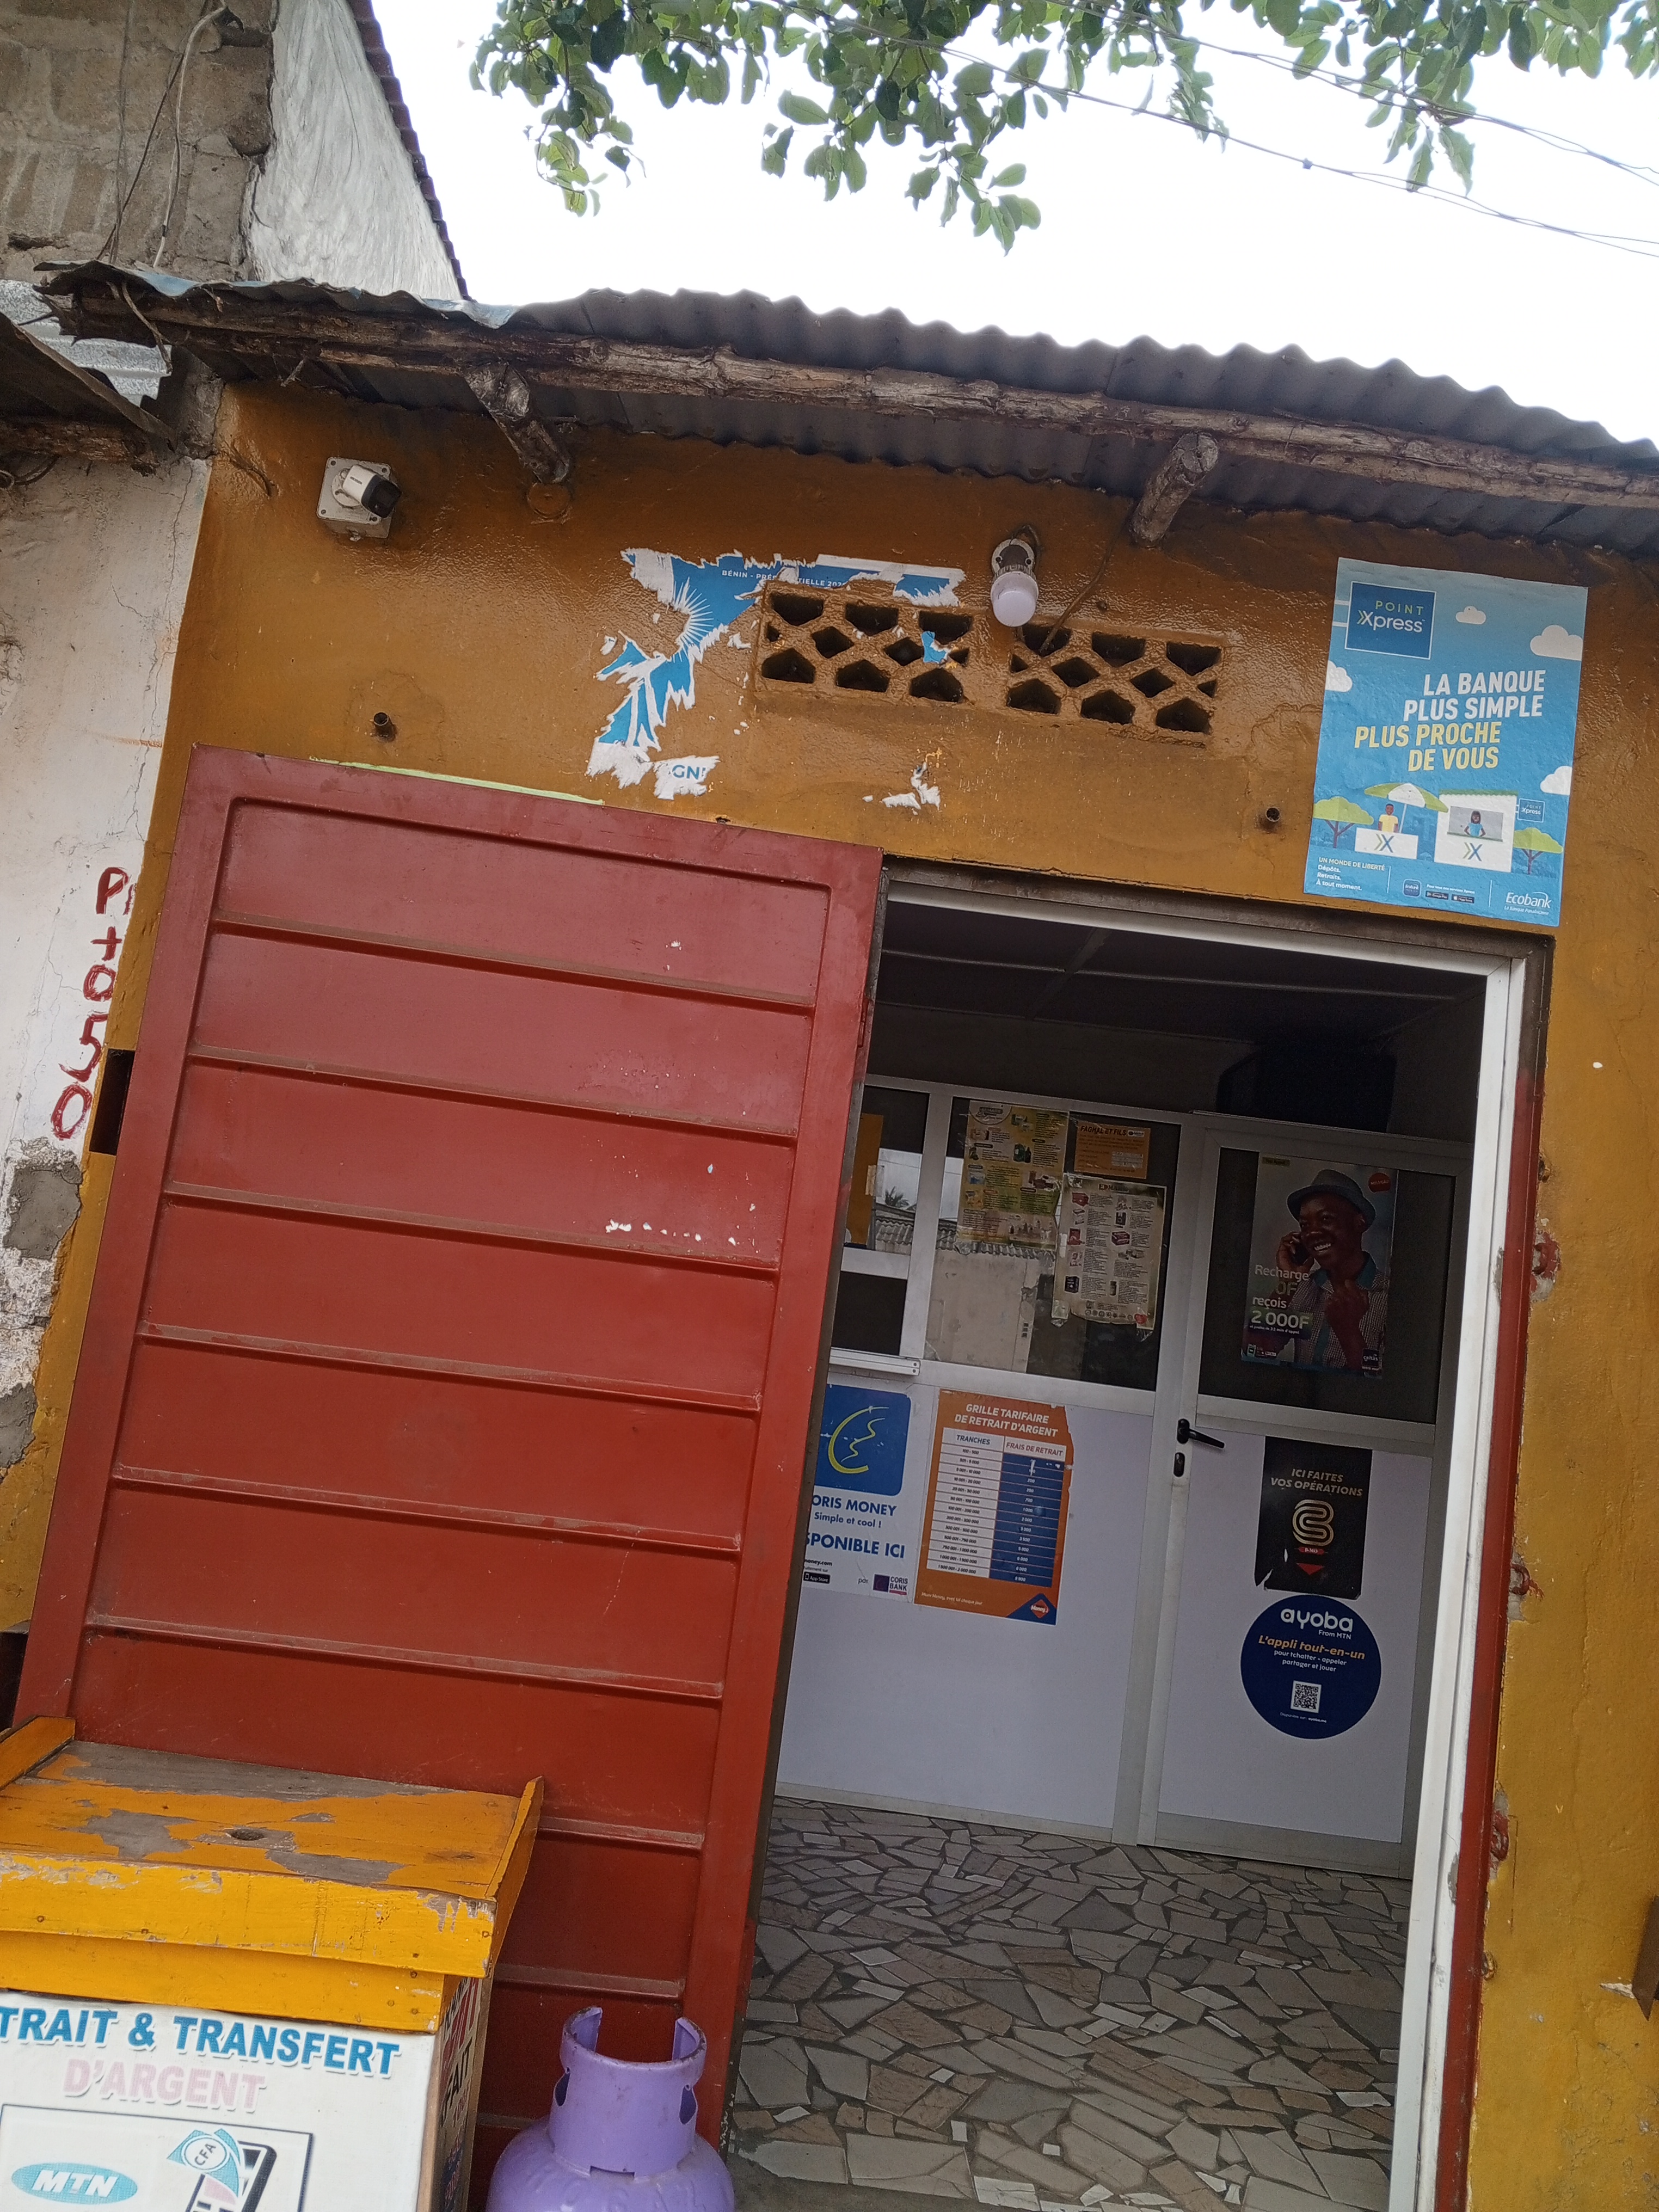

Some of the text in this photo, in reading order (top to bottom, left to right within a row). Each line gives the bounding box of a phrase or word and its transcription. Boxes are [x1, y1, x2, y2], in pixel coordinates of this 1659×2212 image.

[722, 569, 748, 578] BÉNIN
[1375, 600, 1424, 615] POINT
[1360, 610, 1422, 632] Xpress
[1423, 669, 1546, 696] LA BANQUE
[1404, 695, 1544, 722] PLUS SIMPLE
[1354, 721, 1502, 748] PLUS PROCHE
[1408, 746, 1499, 772] DE VOUS
[1318, 864, 1341, 872] Dépôts.
[1329, 858, 1351, 867] MONDE
[1362, 862, 1385, 871] LIBERTÉ
[1317, 872, 1341, 881] Retraits.
[1506, 892, 1552, 909] Ecobank
[1255, 1264, 1309, 1283] Recharge
[1252, 1297, 1287, 1310] reçois
[1251, 1310, 1310, 1329] 2 000F
[966, 1404, 1049, 1424] GRILLE TARIFAIRE
[954, 1414, 1058, 1437] DE RETRAIT D'ARGENT
[956, 1435, 991, 1445] TRANCHES
[1006, 1442, 1025, 1451] FRAIS
[1035, 1447, 1064, 1457] RETRAIT
[1291, 1468, 1343, 1483] ICI FAITES
[1271, 1477, 1363, 1496] VOS OPÉRATIONS
[845, 1499, 898, 1516] MONEY
[814, 1512, 844, 1523] Simple
[857, 1519, 875, 1527] cool
[884, 1543, 905, 1558] ICI
[889, 1583, 907, 1591] BANK
[890, 1576, 908, 1584] CORIS
[1280, 1608, 1353, 1632] ayoba
[1318, 1629, 1335, 1637] From
[1258, 1635, 1366, 1660] L'appli tout-en-un
[1282, 1659, 1311, 1668] partager
[1319, 1663, 1337, 1672] jouer
[1290, 1651, 1317, 1661] tchatter
[1322, 1657, 1347, 1666] appeler
[0, 2006, 400, 2075] TRAIT & TRANSFERT
[63, 2059, 266, 2109] D'ARGENT
[194, 2143, 216, 2166] CFA
[32, 2169, 119, 2197] MTN
